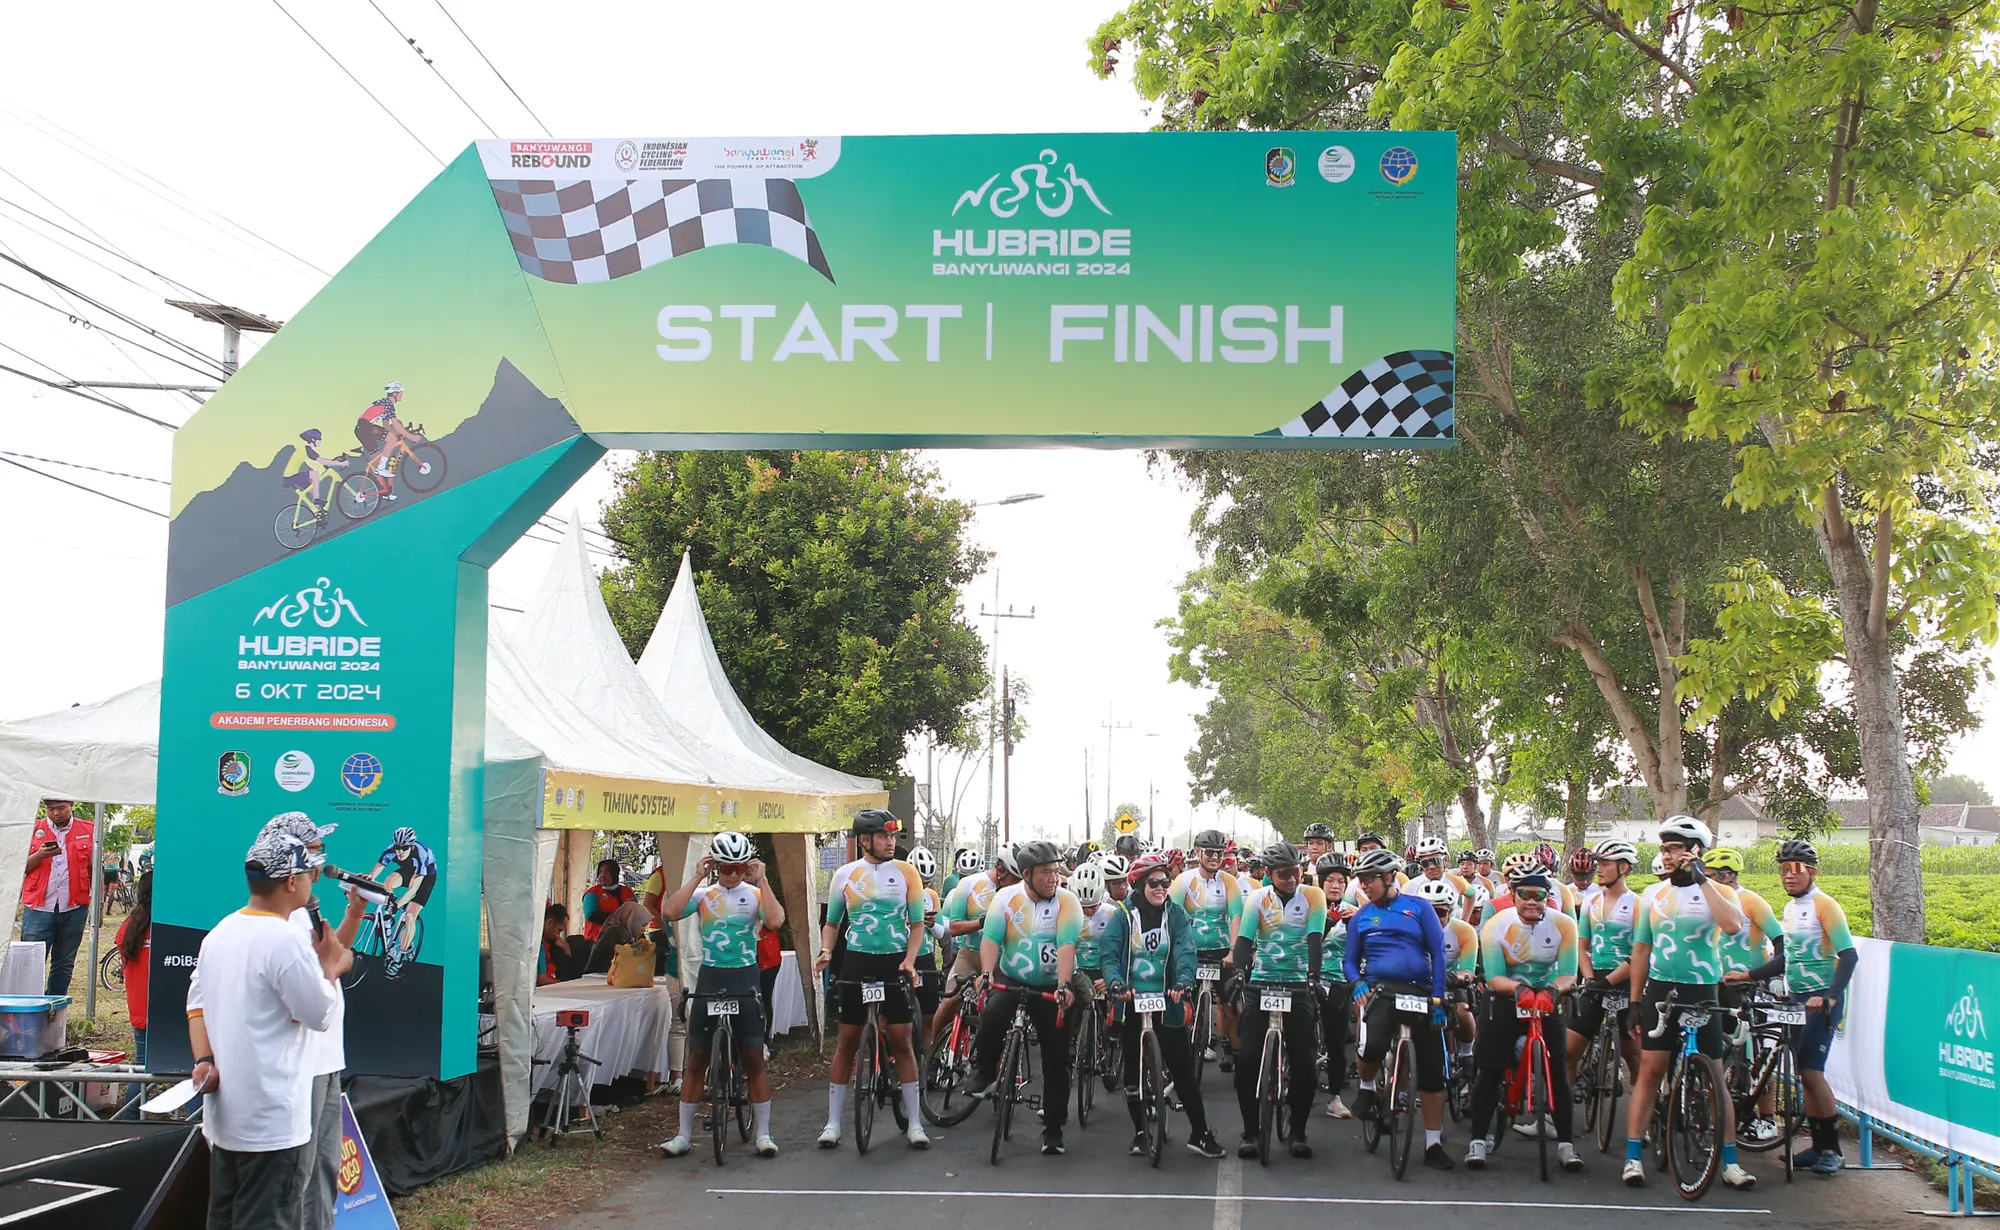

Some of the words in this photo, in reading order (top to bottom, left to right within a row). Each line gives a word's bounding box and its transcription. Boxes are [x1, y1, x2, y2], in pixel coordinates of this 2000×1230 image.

[516, 143, 587, 152] BANYUWANGI
[643, 142, 688, 150] INDONESIAN
[724, 147, 794, 160] banyuwangi
[511, 154, 591, 169] REBOUND
[640, 159, 684, 167] FEDERATION
[933, 229, 1131, 257] HUBRIDE
[933, 263, 1070, 275] BANYUWANGI
[1076, 263, 1130, 275] 2024
[656, 301, 962, 362] START
[1050, 304, 1344, 363] FINISH
[238, 635, 381, 657] HUBRIDE
[237, 660, 336, 671] BANYUWANGI
[340, 661, 380, 671] 2024
[235, 683, 250, 699] 6
[261, 684, 307, 699] OKT
[317, 684, 381, 700] 2024
[218, 715, 265, 726] AKADEMI
[267, 716, 330, 727] PENERBANG
[333, 717, 388, 728] INDONESIA
[602, 791, 638, 815] TIMING
[640, 794, 675, 816] SYSTEM
[758, 802, 785, 819] MEDICAL
[1198, 970, 1217, 979] 677
[713, 1001, 738, 1013] 648
[1139, 999, 1164, 1011] 680
[1263, 998, 1286, 1010] 641
[1401, 1000, 1422, 1011] 614
[1777, 1011, 1802, 1023] 607
[1939, 1042, 1994, 1074] HUBRIDE
